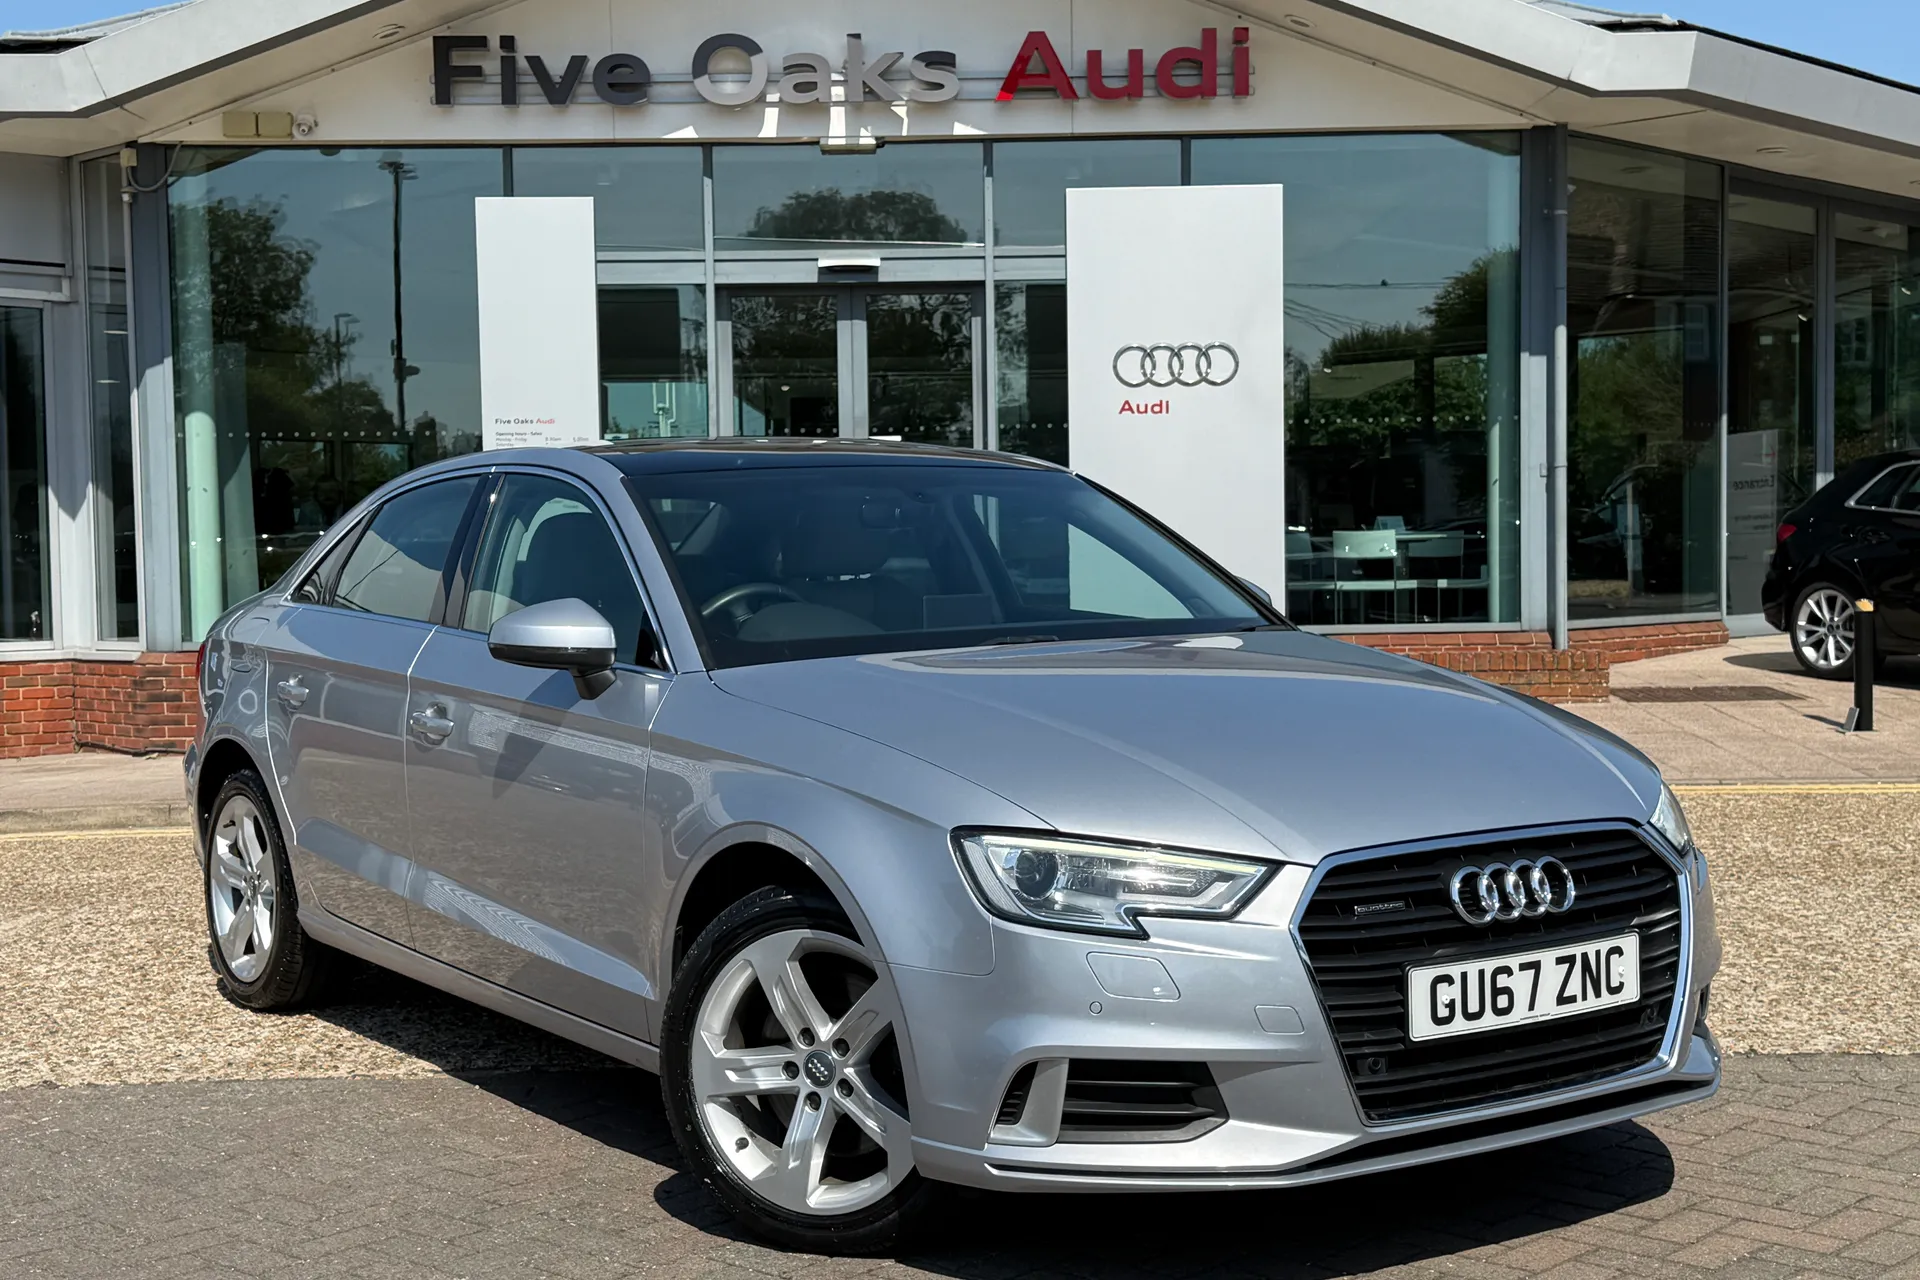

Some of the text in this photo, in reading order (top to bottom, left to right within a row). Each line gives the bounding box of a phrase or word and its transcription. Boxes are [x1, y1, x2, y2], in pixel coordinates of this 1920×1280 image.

[433, 27, 1250, 107] Five Oaks Audi
[513, 417, 534, 425] Oaks
[536, 417, 556, 425] Audi
[1118, 399, 1170, 415] Audi
[1430, 945, 1625, 1027] GU67 ZNC
